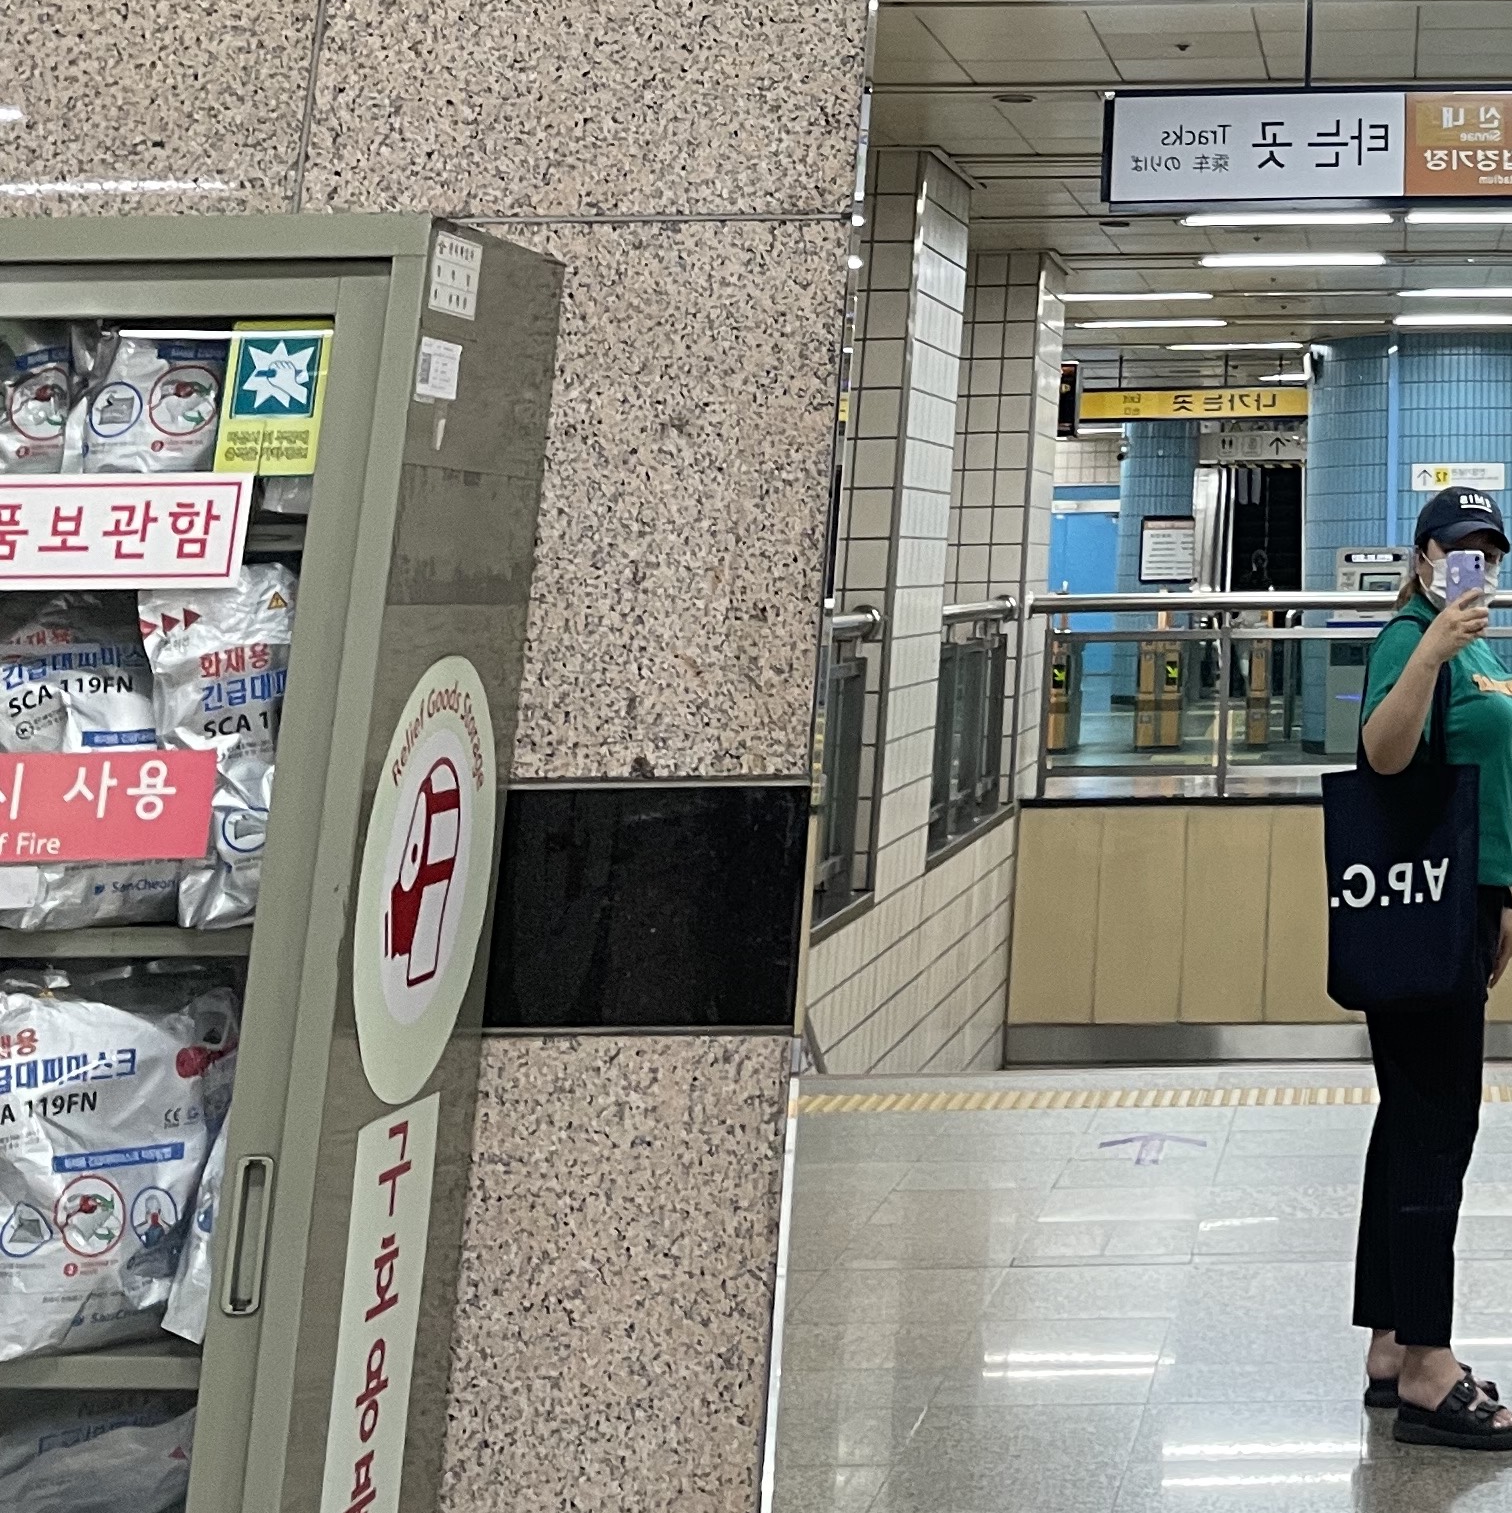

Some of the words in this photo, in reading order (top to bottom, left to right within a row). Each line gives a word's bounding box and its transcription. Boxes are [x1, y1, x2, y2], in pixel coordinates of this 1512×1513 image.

[200, 642, 270, 678] 화재용
[8, 685, 52, 718] SCA
[60, 675, 134, 694] 119FN
[203, 714, 252, 739] SCA
[62, 759, 177, 821] 사용
[16, 832, 61, 855] Fire
[25, 1091, 98, 1122] 119FN
